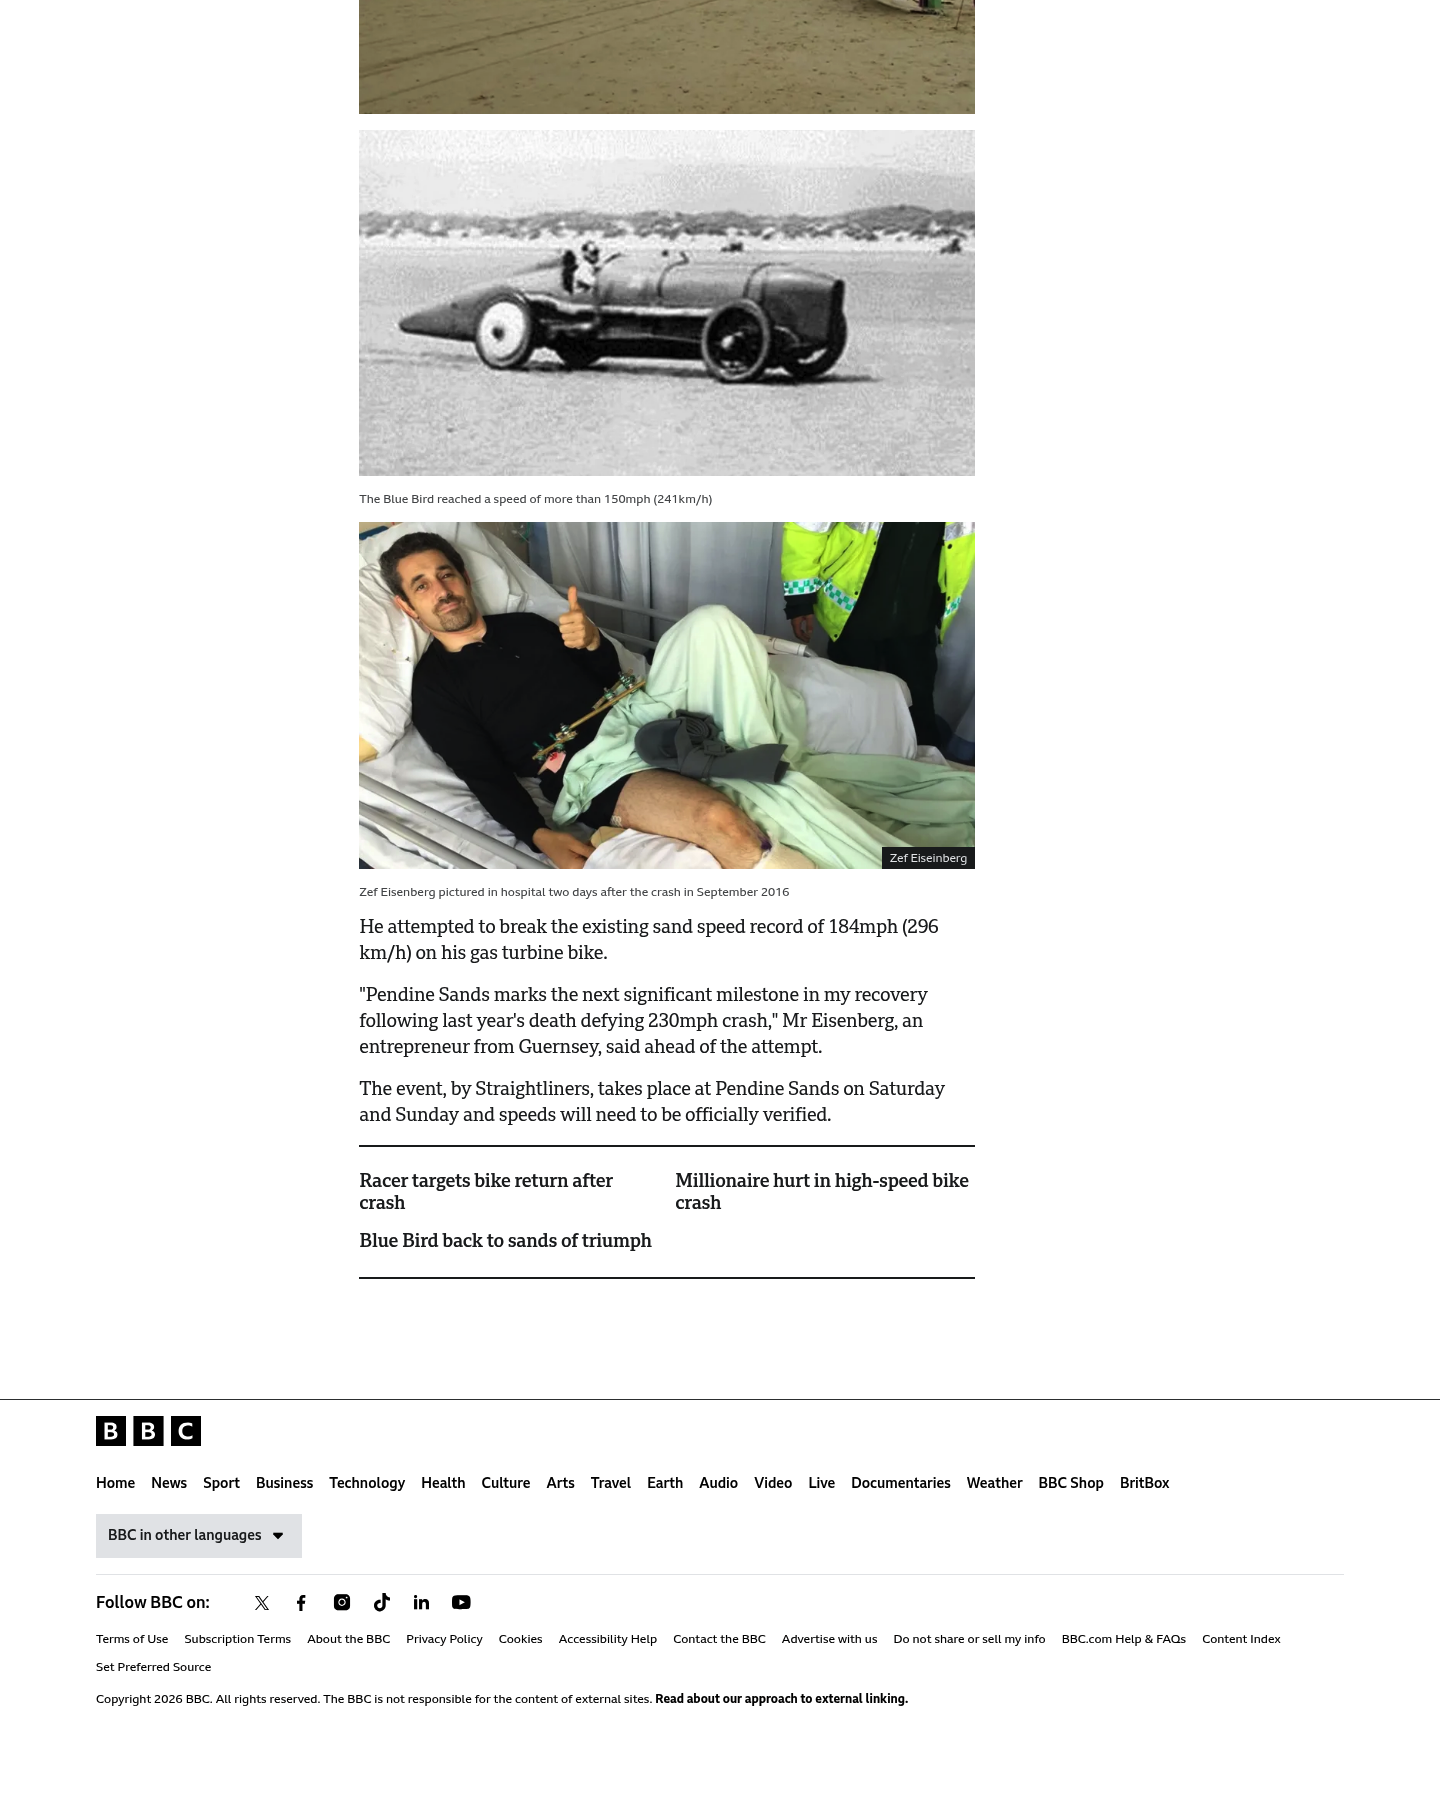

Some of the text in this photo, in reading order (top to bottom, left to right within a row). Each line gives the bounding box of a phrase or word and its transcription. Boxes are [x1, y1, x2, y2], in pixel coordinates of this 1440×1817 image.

[358, 494, 713, 507] The Blue Bird reached a speed of more than 150mph (241km/h)
[359, 886, 790, 900] Zef Eisenberg pictured in hospital two days after the crash in September 2016
[359, 918, 939, 938] He attempted to break the existing sand speed record of 184mph (296
[359, 1172, 614, 1192] Racer targets bike return after
[675, 1172, 970, 1192] Millionaire hurt in high-speed bike
[359, 1194, 406, 1210] crash
[675, 1194, 722, 1210] crash
[96, 1476, 136, 1489] Home
[151, 1476, 188, 1489] News
[203, 1476, 241, 1492] Sport
[256, 1476, 314, 1489] Business
[328, 1476, 406, 1492] Technology
[481, 1476, 531, 1489] Culture
[851, 1476, 952, 1489] Documentaries
[1120, 1476, 1170, 1489] BritBox
[108, 1528, 262, 1544] BBC in other languages
[96, 1594, 210, 1609] Follow BBC on:
[95, 1634, 169, 1644] Terms of Use
[406, 1634, 484, 1647] Privacy Policy
[558, 1634, 658, 1647] Accessibility Help
[893, 1634, 1046, 1647] Do not share or sell my info
[1202, 1634, 1282, 1644] Content Index
[95, 1662, 212, 1672] Set Preferred Source
